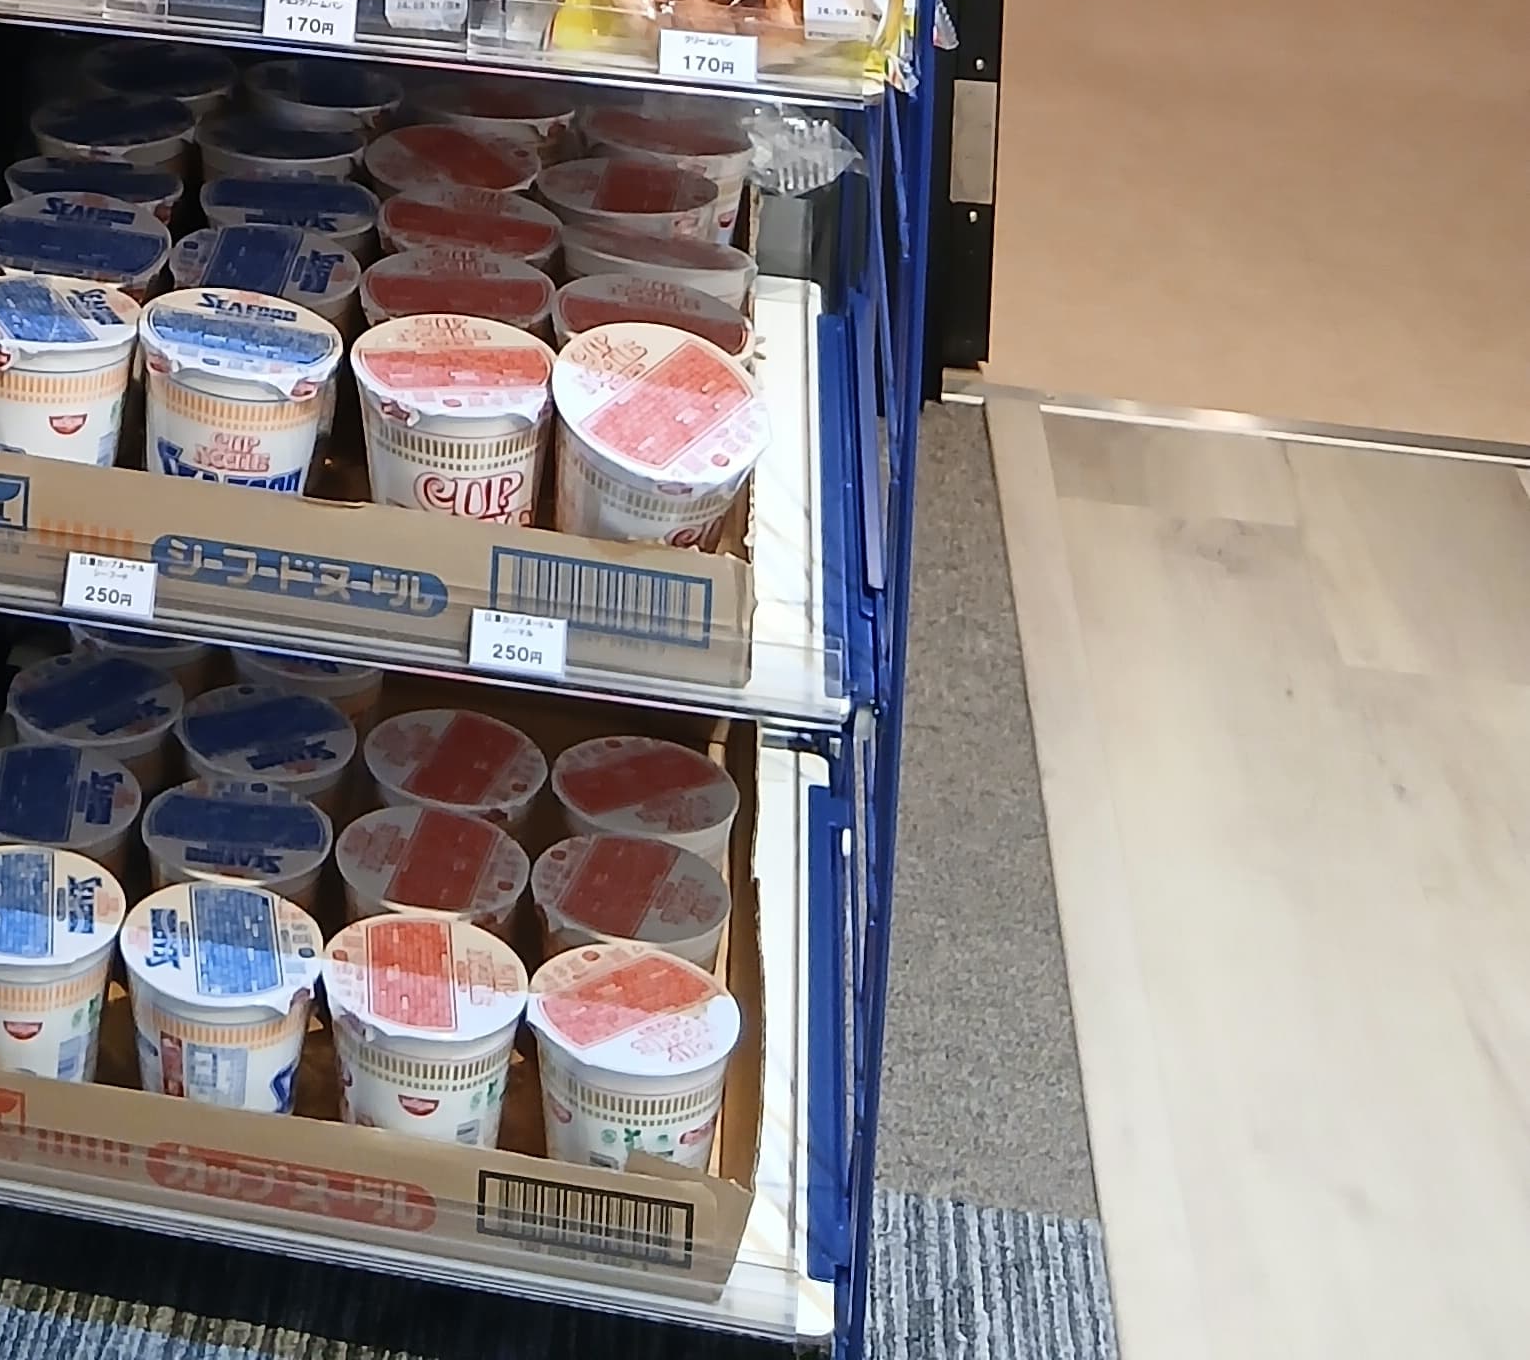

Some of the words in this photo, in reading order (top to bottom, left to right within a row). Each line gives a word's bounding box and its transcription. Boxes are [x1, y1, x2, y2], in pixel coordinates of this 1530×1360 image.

[285, 16, 335, 36] 170円
[683, 55, 735, 75] 170円
[198, 292, 298, 323] SEAFOOD
[414, 471, 525, 519] CUP
[167, 538, 434, 611] シーフードヌードル
[84, 585, 132, 607] 250円
[491, 643, 543, 665] 250円
